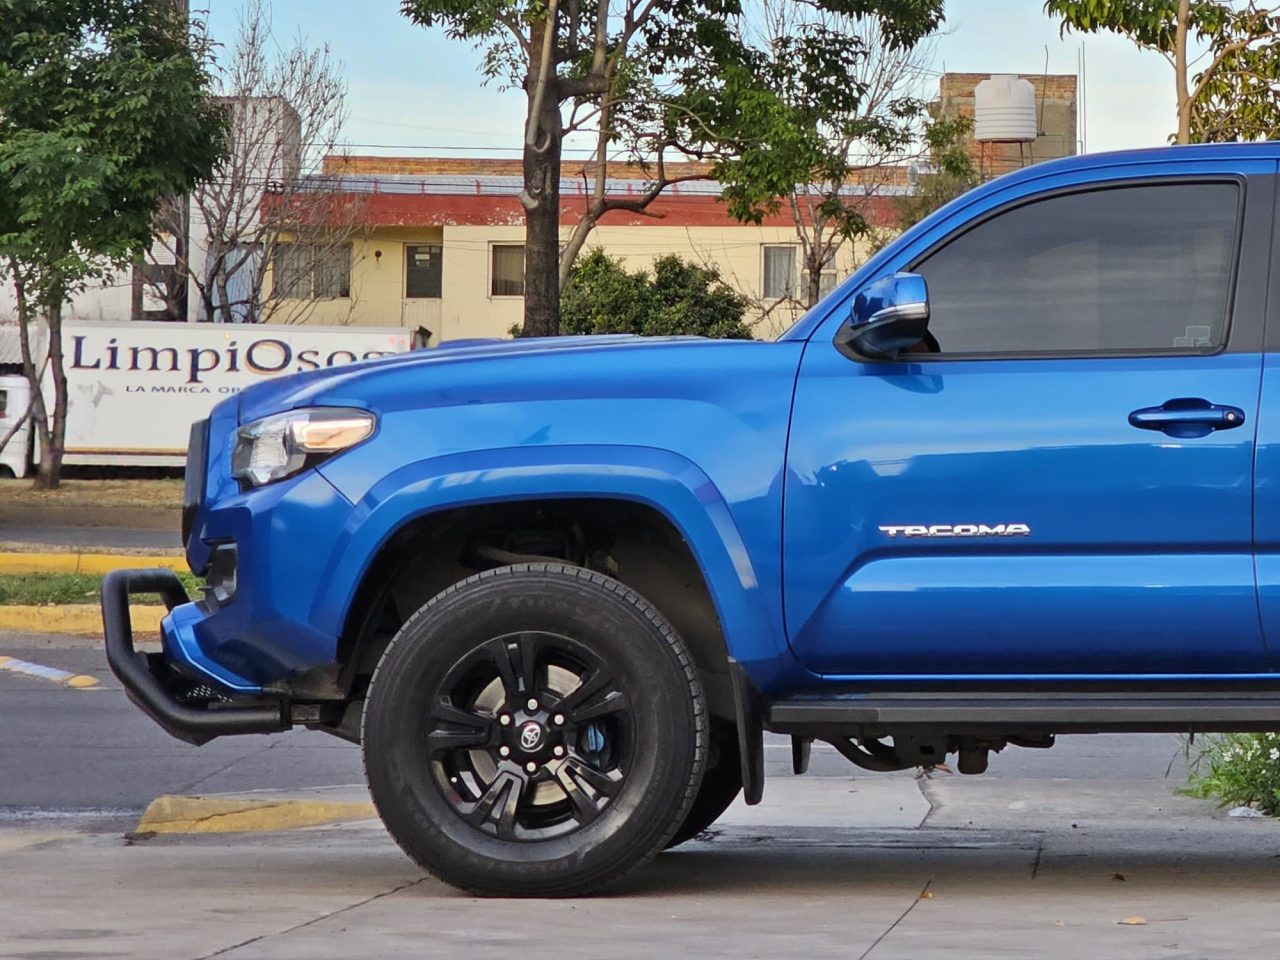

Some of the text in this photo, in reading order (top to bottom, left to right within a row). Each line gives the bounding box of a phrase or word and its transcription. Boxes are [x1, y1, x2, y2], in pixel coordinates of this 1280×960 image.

[126, 385, 146, 393] LA
[151, 385, 211, 393] MARCA
[878, 524, 1030, 537] TACOMA
